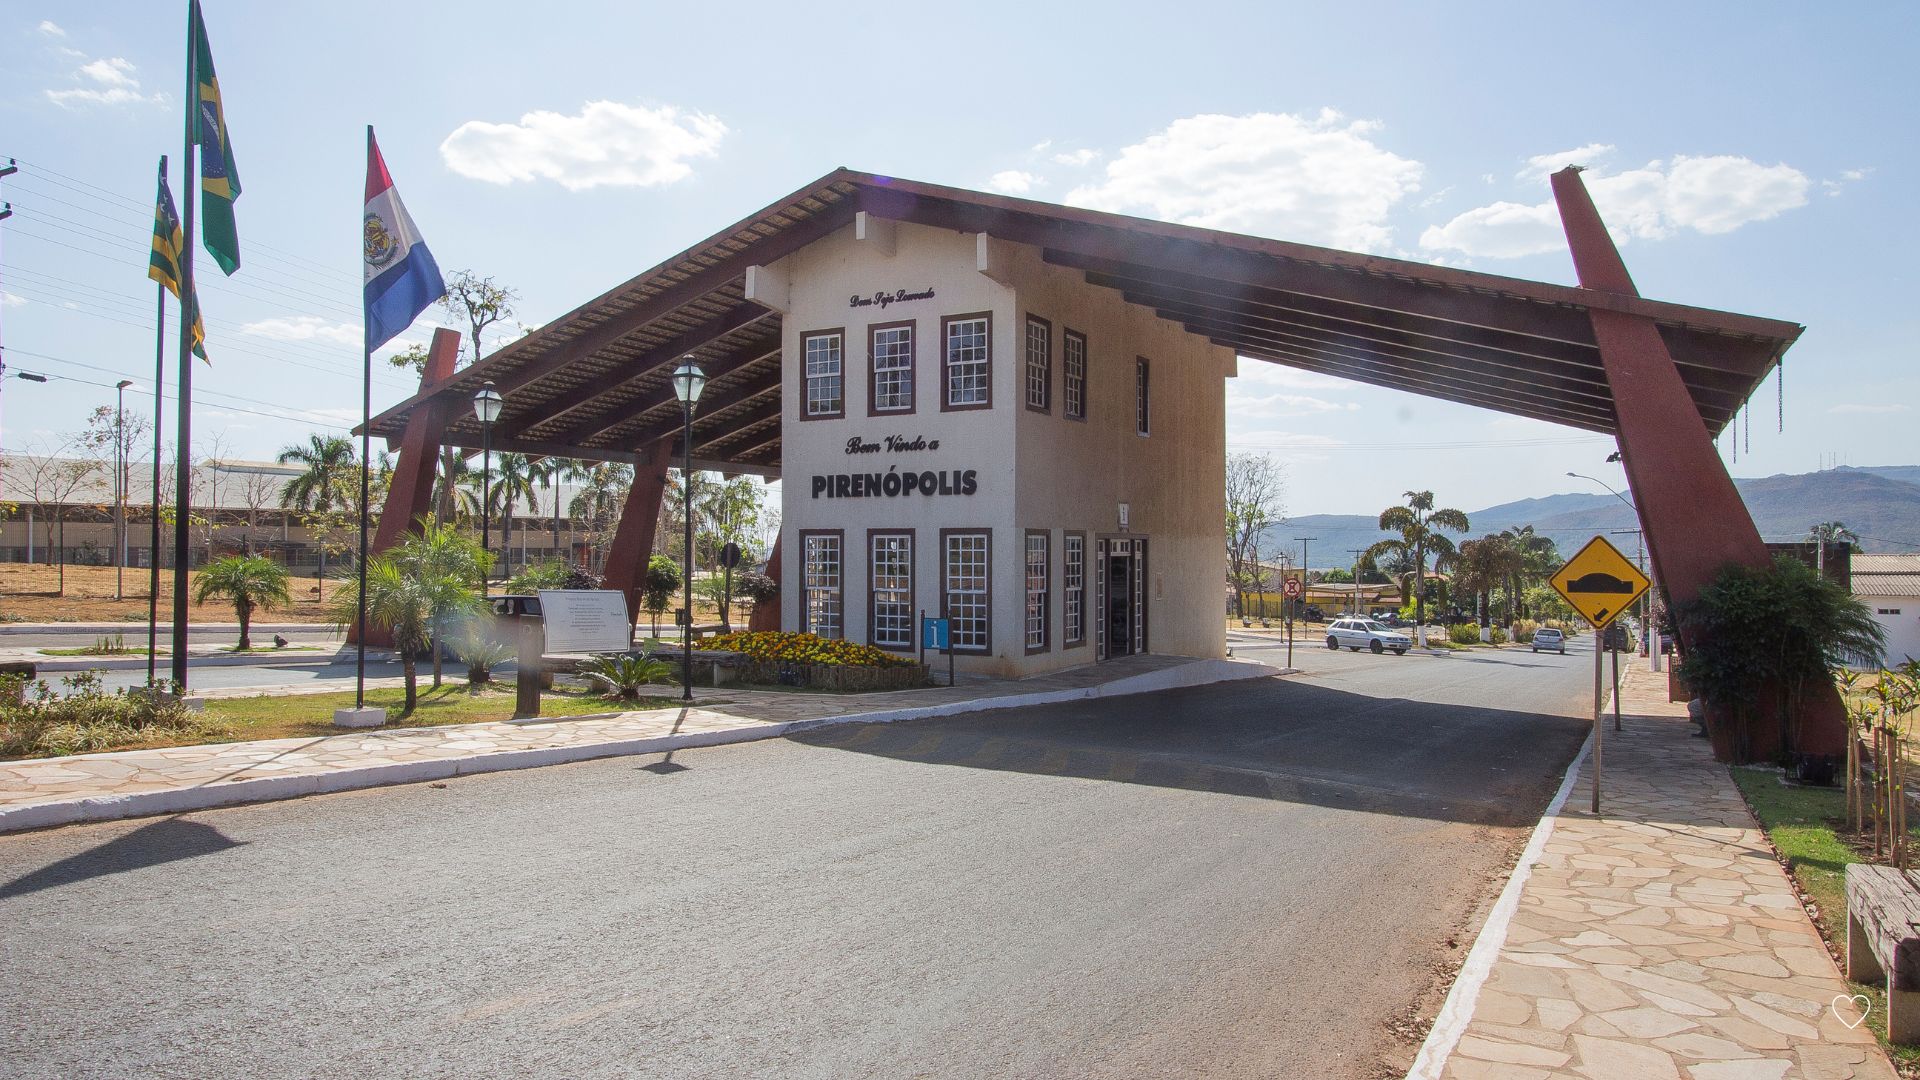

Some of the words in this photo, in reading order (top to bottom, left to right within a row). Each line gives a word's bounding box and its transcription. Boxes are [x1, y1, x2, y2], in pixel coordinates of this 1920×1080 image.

[845, 436, 881, 454] Bem
[884, 434, 927, 453] Vindo
[928, 440, 939, 450] a
[812, 465, 977, 498] PIRENÓPOLIS
[931, 620, 940, 648] i
